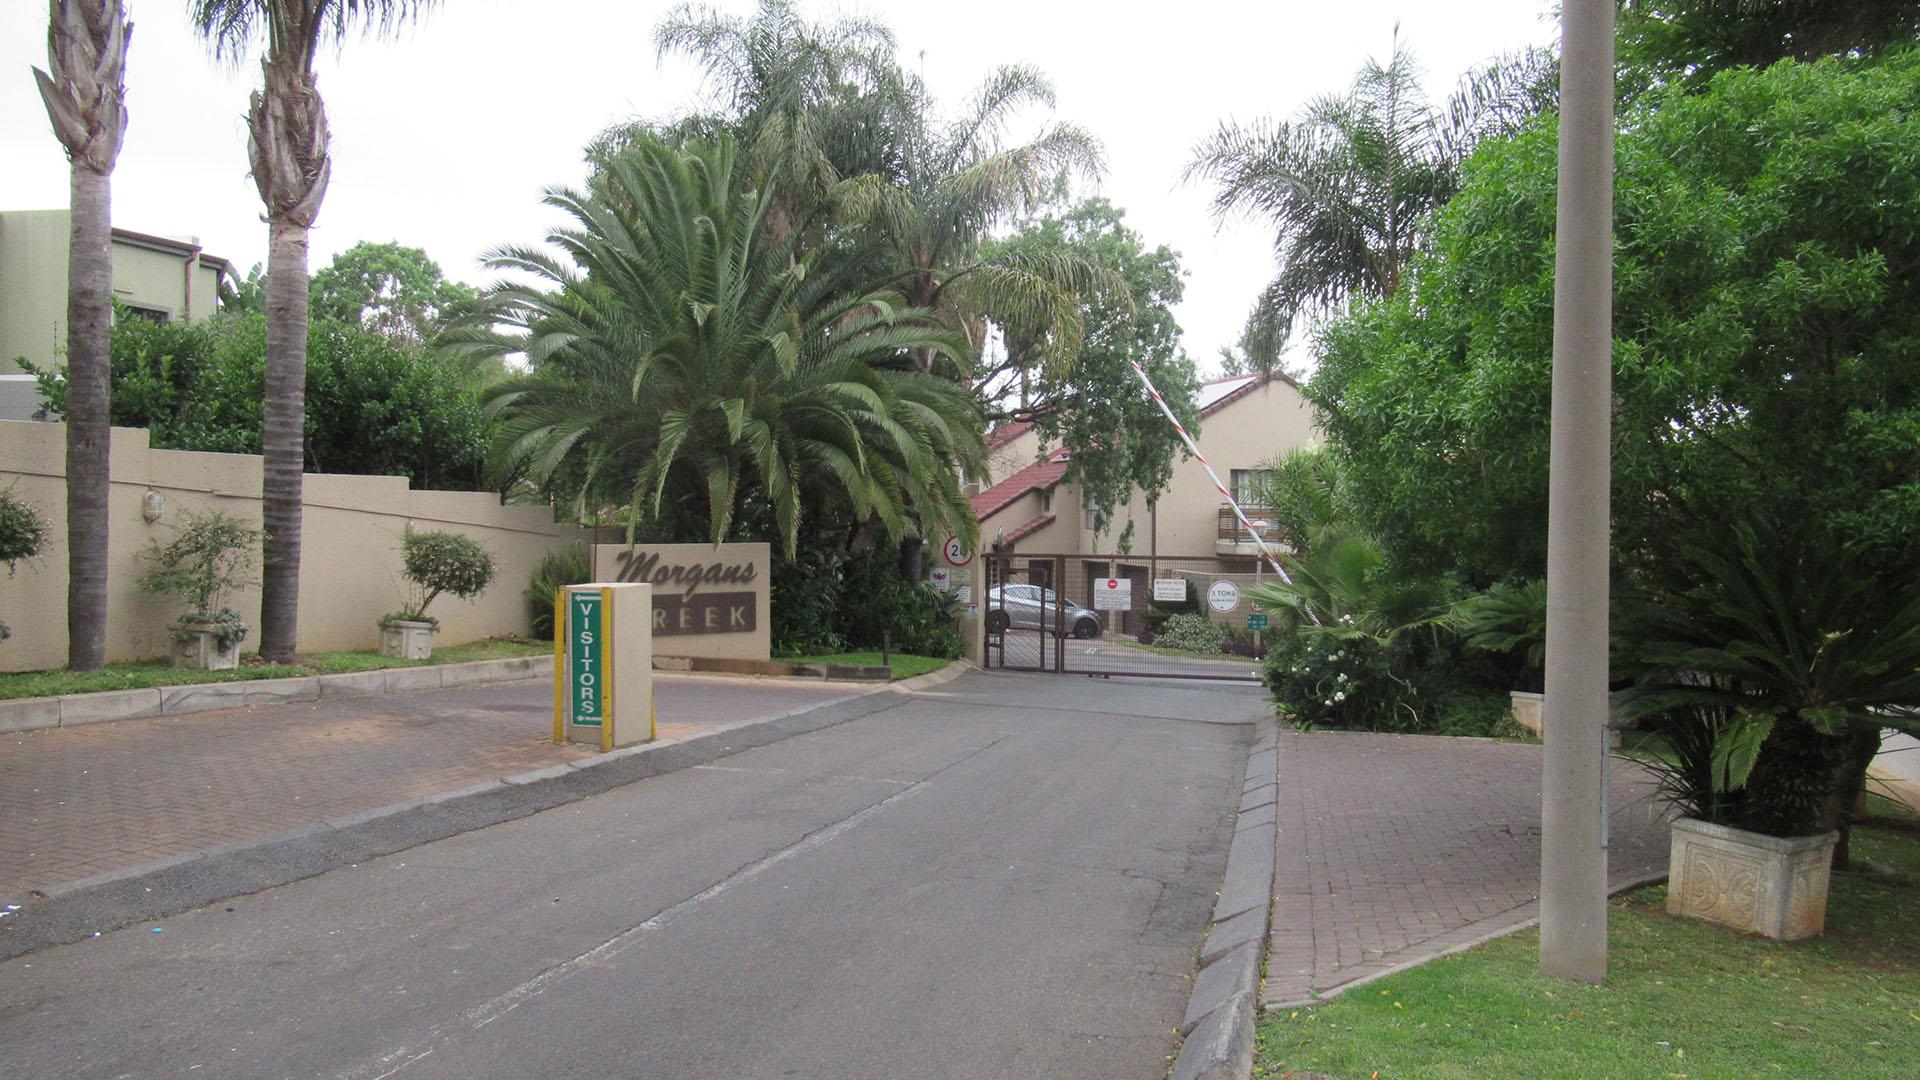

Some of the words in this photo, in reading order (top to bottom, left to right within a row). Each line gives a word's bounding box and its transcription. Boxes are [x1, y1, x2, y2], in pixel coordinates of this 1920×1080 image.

[615, 550, 760, 602] Morgans
[652, 606, 746, 629] REEK
[579, 603, 595, 714] VISITORS
